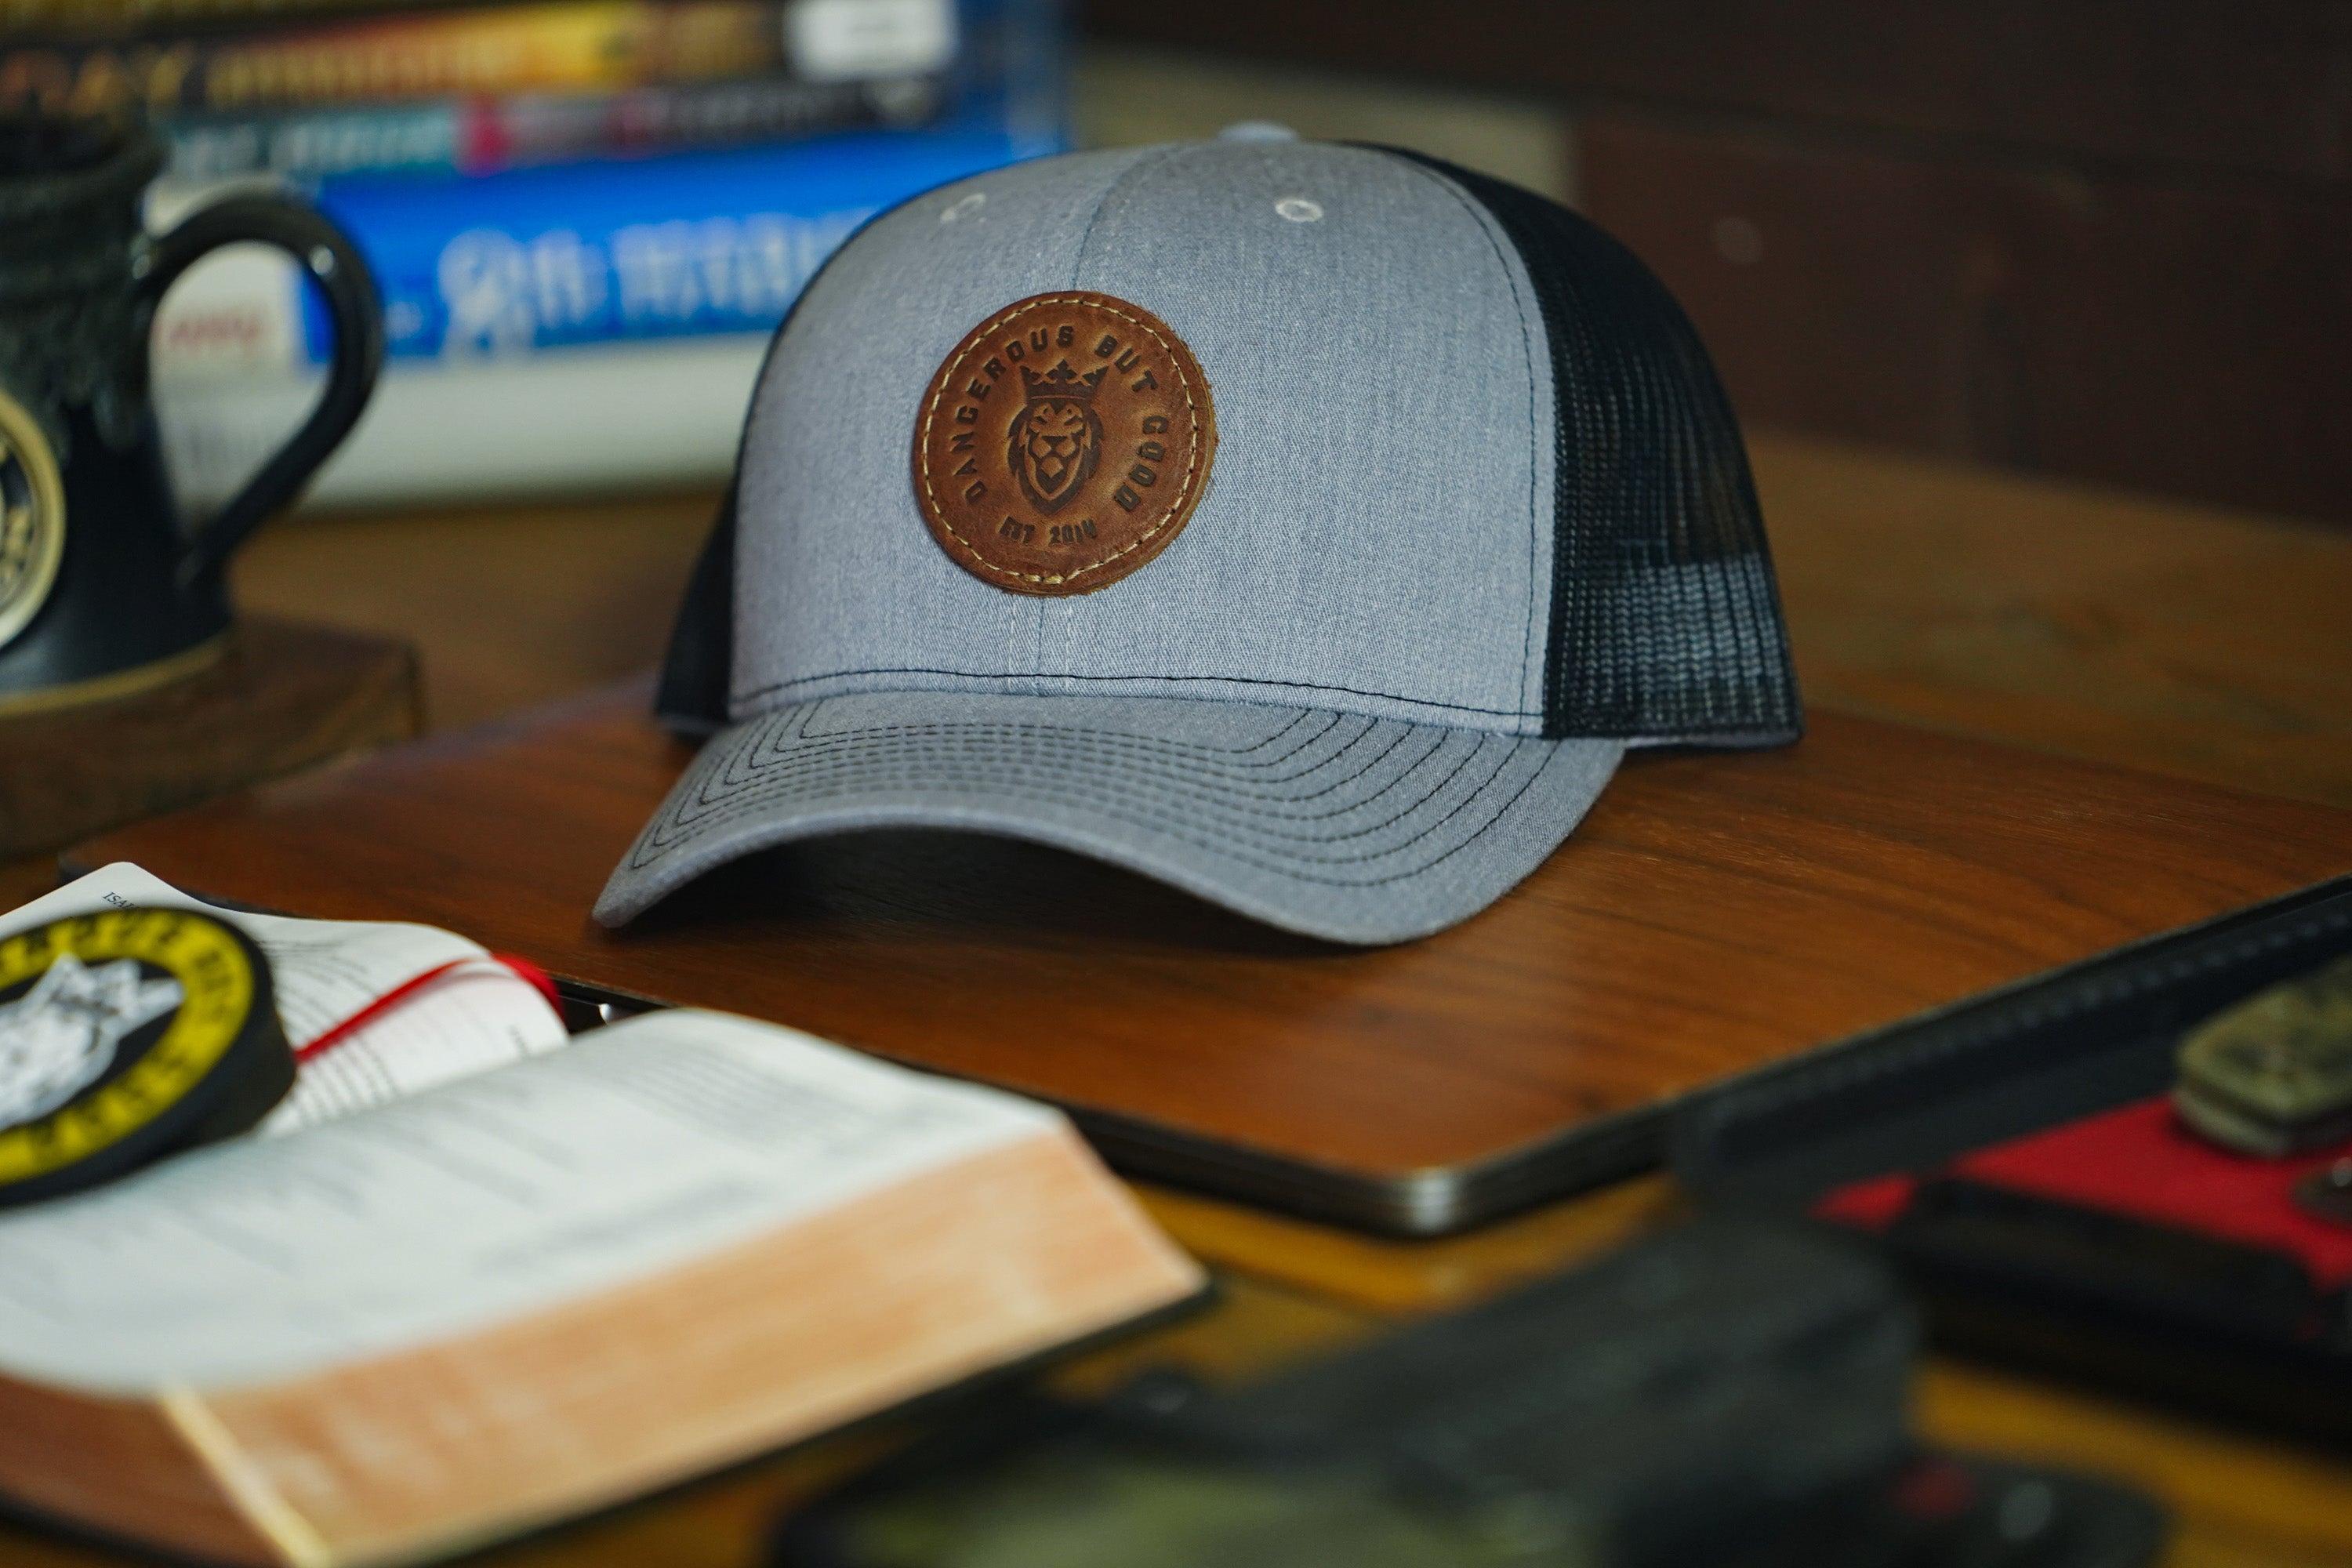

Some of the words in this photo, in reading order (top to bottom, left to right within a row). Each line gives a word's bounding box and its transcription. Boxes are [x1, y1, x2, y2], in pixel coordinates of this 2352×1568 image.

[1095, 335, 1159, 393] BUT
[950, 325, 1074, 506] DANGEROUS
[1113, 414, 1170, 513] GOOD
[102, 891, 137, 909] ISAI
